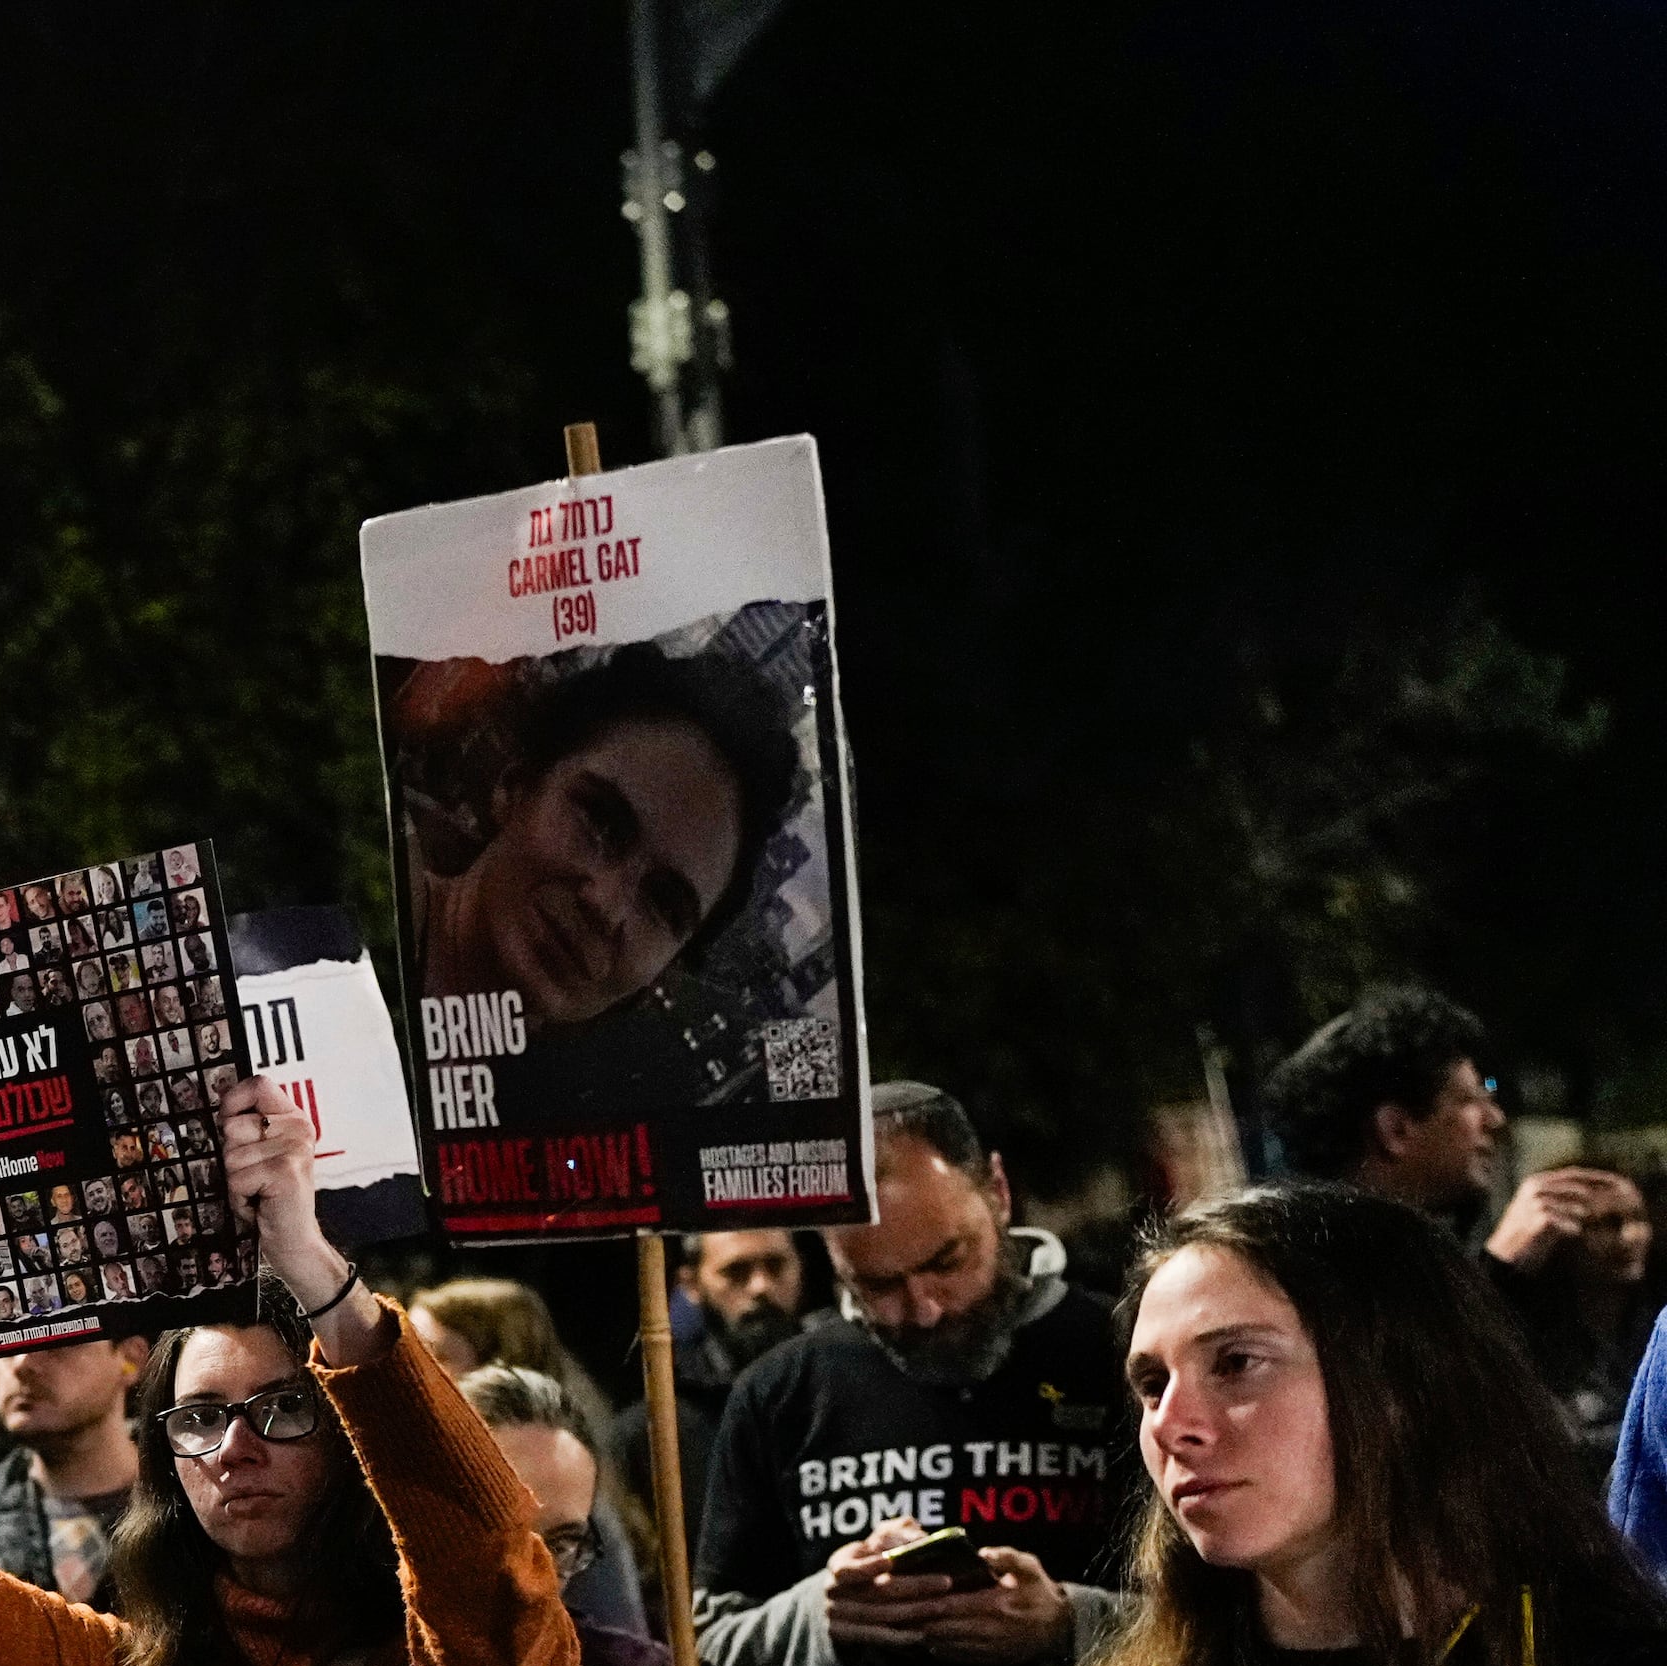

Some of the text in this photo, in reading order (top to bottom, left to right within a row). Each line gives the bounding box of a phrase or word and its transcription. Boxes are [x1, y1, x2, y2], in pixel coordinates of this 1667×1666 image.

[529, 495, 613, 548] כרמל גת
[509, 537, 642, 598] CARMEL GAT
[553, 589, 597, 641] (39)
[21, 1023, 58, 1073] לא
[421, 990, 527, 1061] BRING
[428, 1063, 500, 1131] HER
[438, 1123, 656, 1204] HOME NOW!
[703, 1162, 849, 1202] FAMILIES FORUM
[799, 1441, 1107, 1497] BRING THEM
[800, 1488, 945, 1540] HOME
